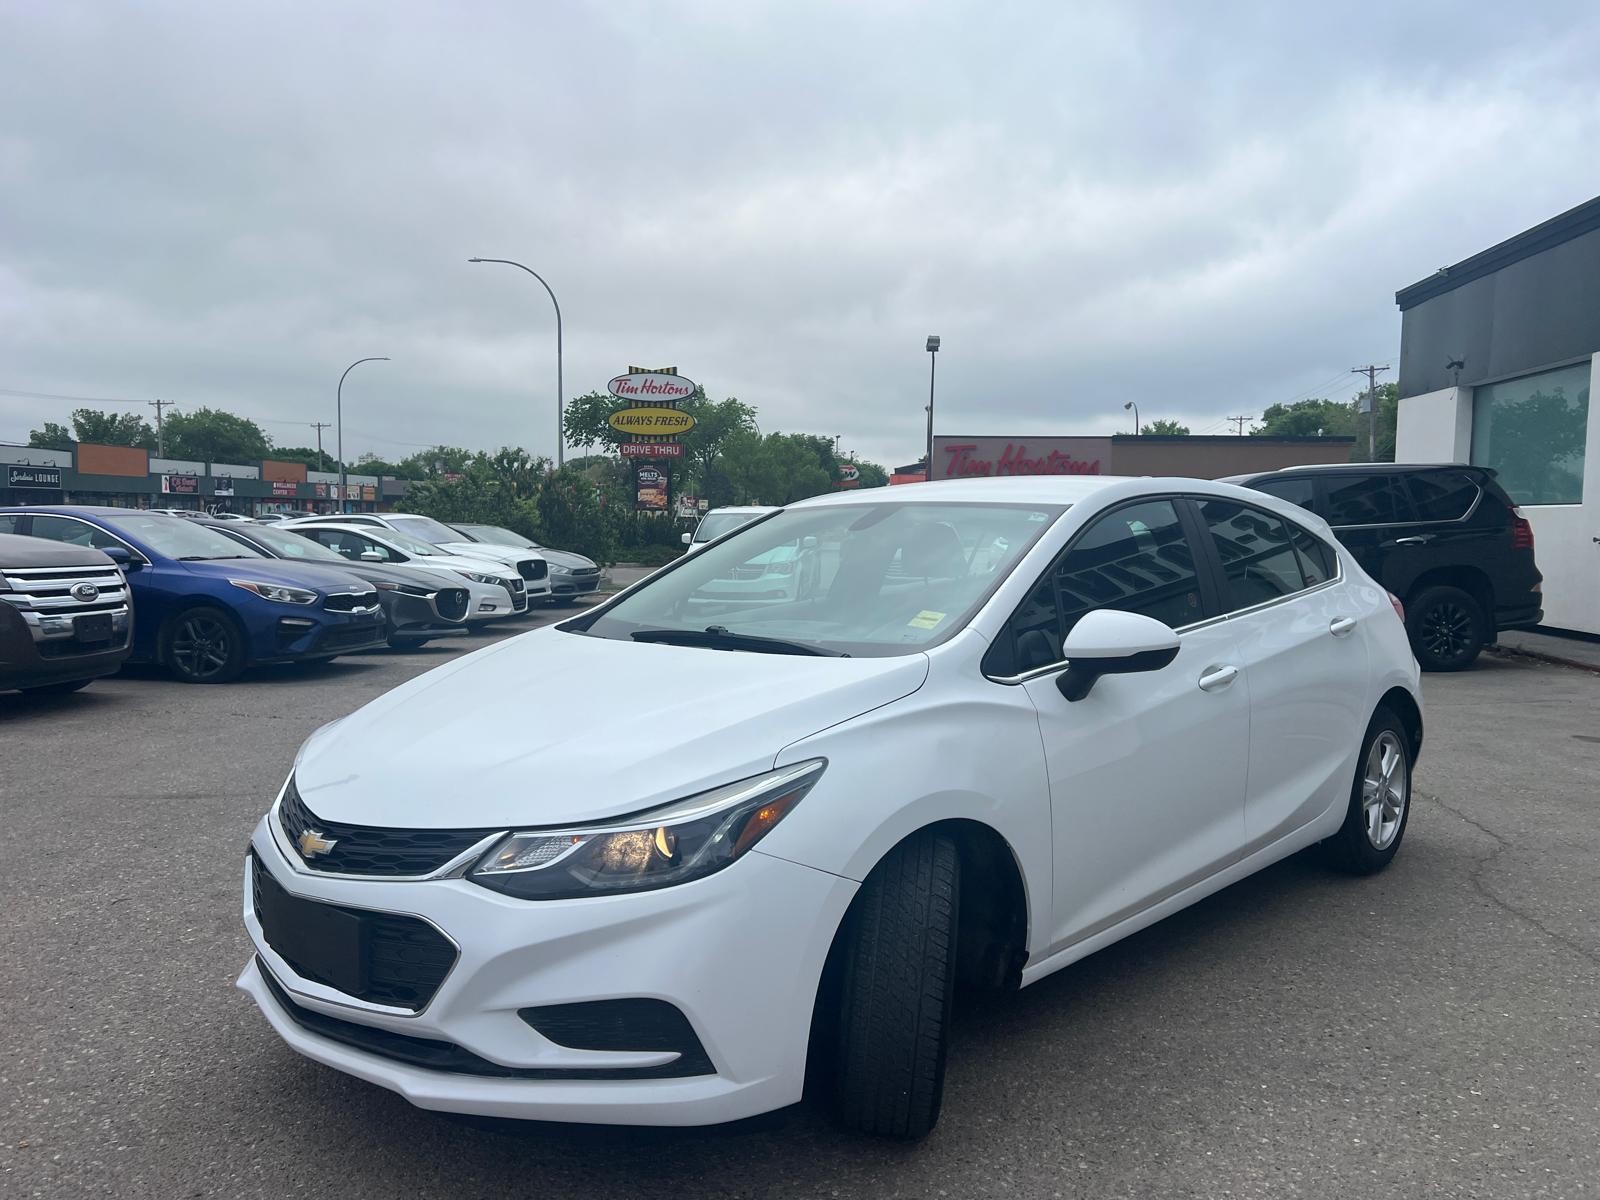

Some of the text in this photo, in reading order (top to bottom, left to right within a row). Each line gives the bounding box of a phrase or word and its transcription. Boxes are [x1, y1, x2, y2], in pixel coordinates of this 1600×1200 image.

[614, 378, 689, 395] Tim Hortons
[613, 415, 689, 427] ALWAYS FRESH
[623, 445, 680, 455] DRIVE THRU
[944, 443, 1101, 476] Tim Hortons
[35, 473, 59, 483] LOUNGE
